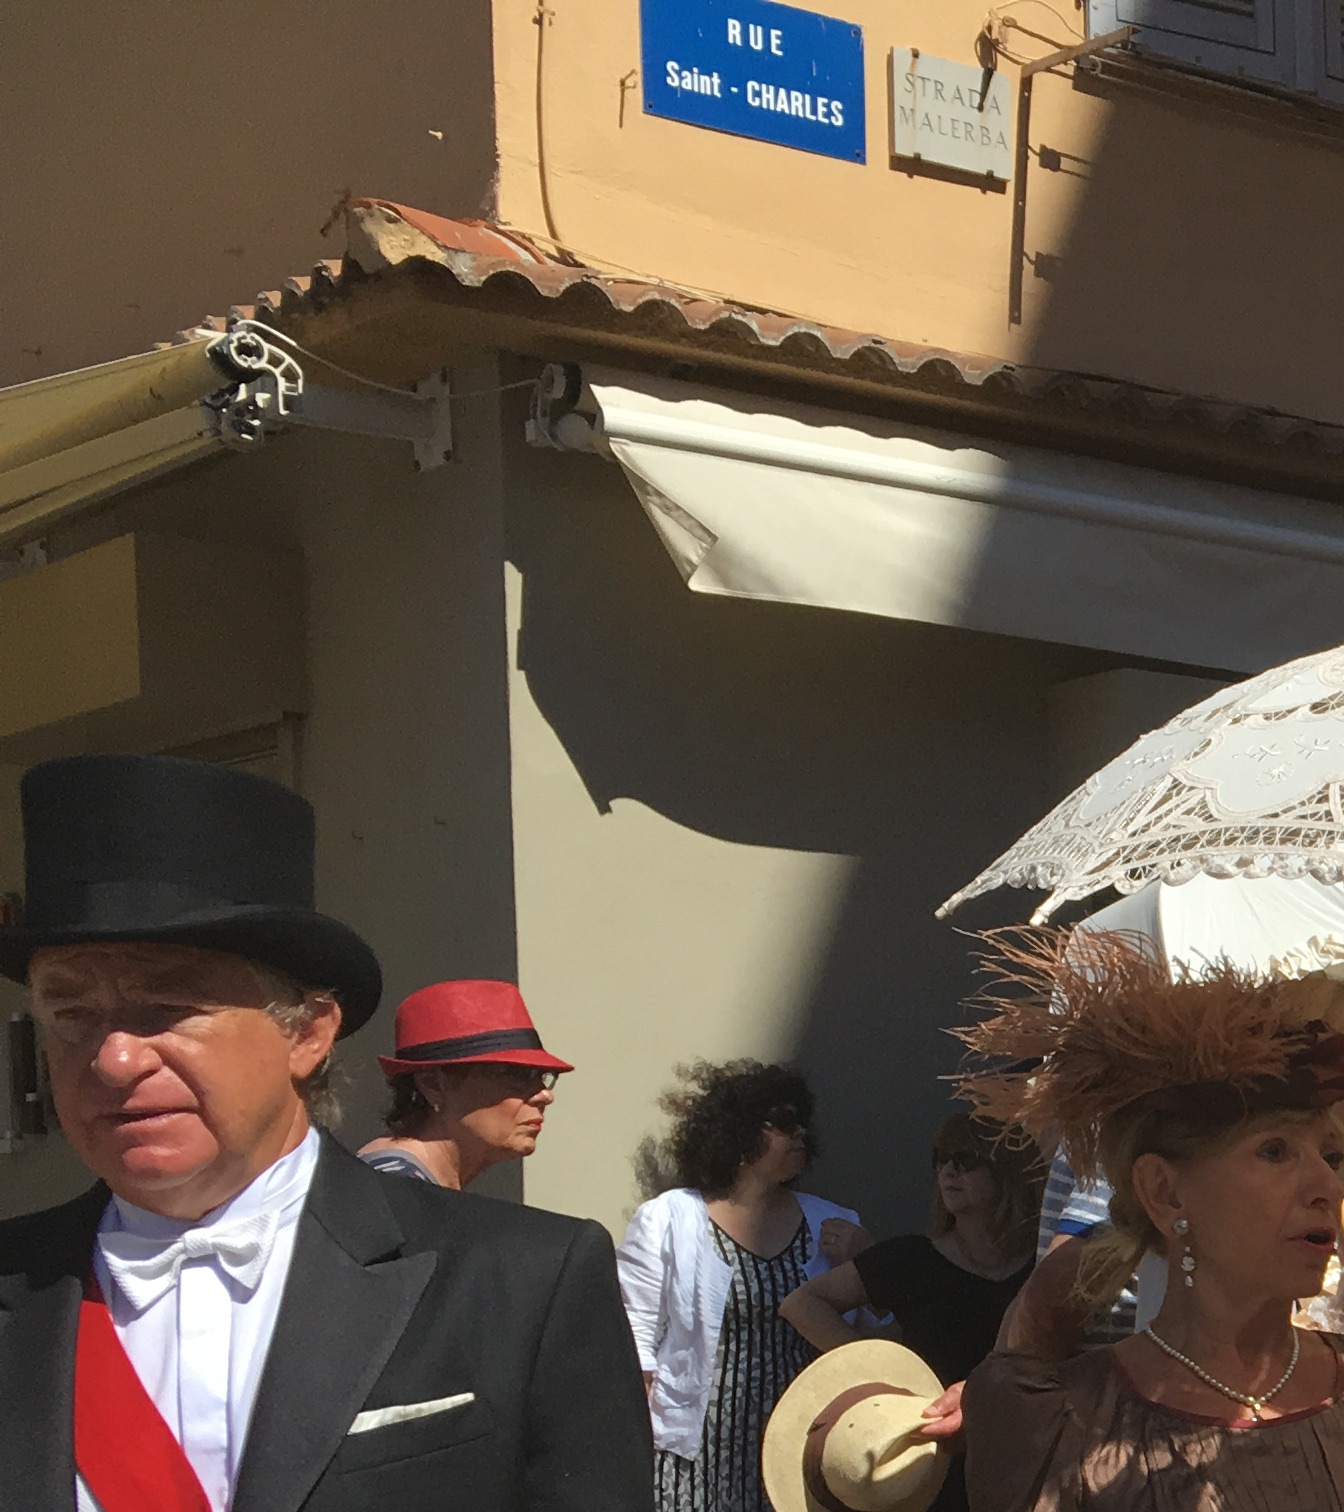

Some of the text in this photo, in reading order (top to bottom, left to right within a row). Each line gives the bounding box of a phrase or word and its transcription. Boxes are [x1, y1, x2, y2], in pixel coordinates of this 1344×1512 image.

[727, 18, 784, 56] RUE
[666, 61, 721, 98] Saint
[747, 80, 844, 126] CHARLES
[904, 72, 1002, 116] STRADA
[899, 105, 1009, 151] MALERBA
